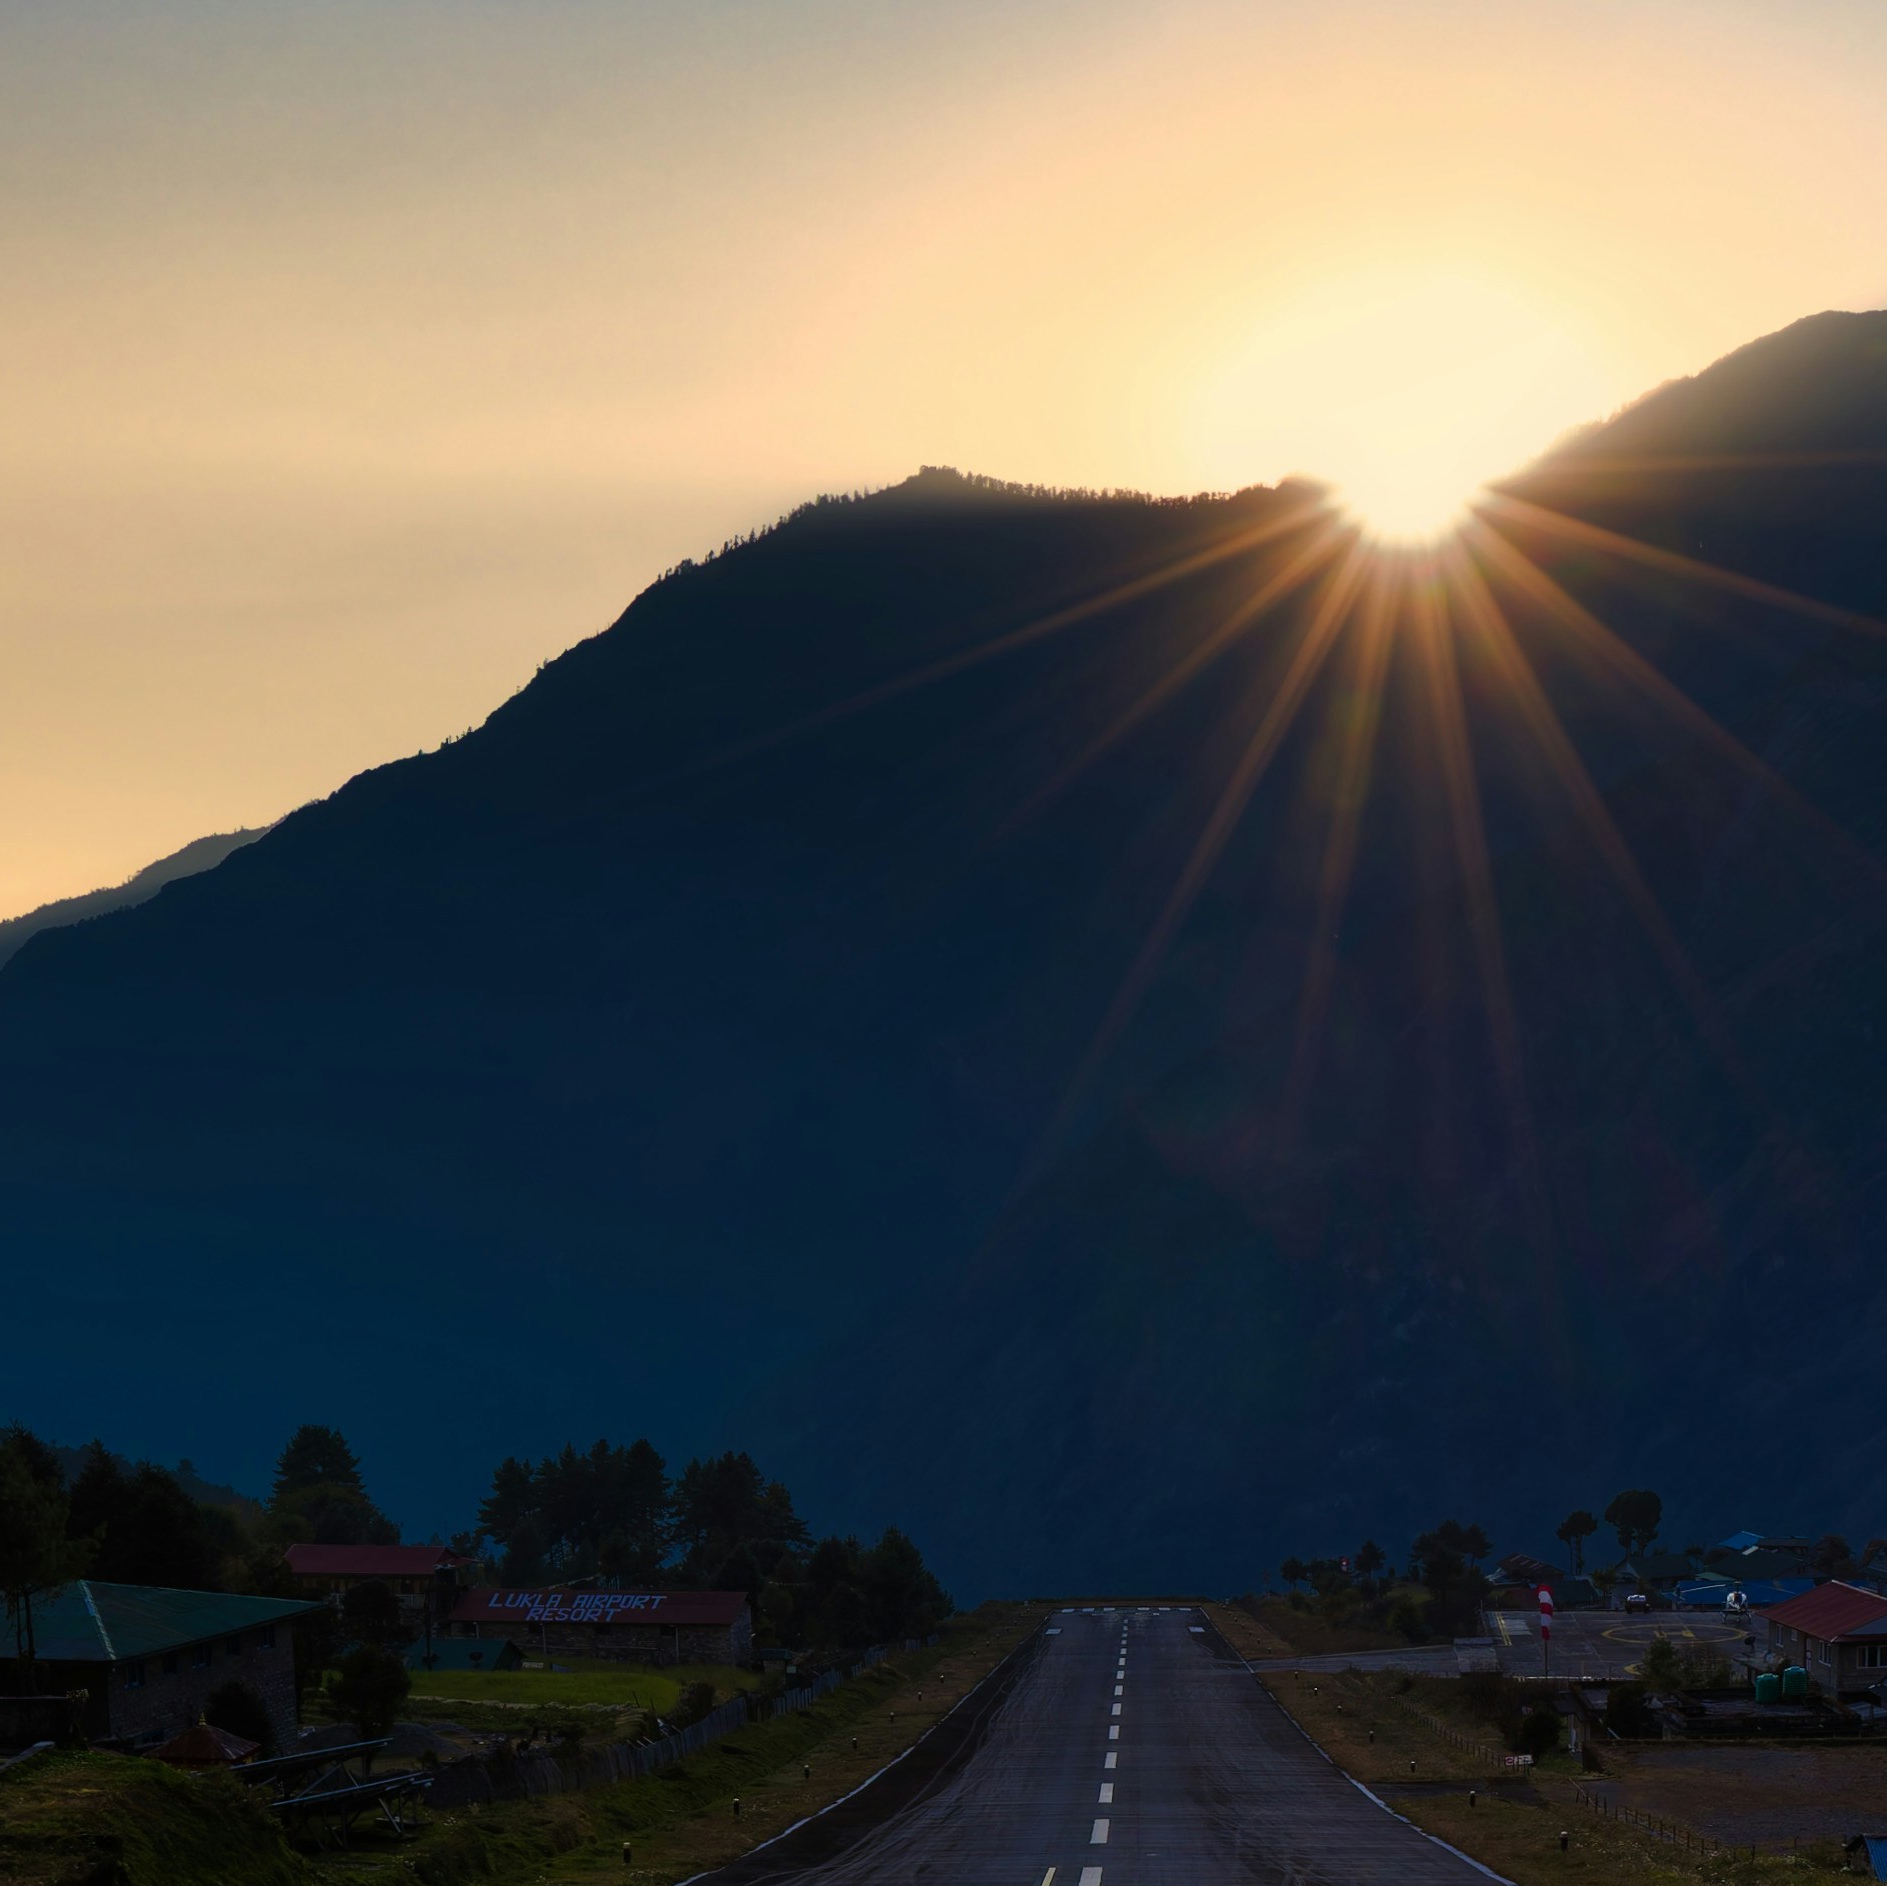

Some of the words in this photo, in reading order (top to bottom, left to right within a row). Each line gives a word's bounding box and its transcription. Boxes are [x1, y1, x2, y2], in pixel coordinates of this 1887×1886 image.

[488, 1592, 563, 1608] LUKLA
[572, 1594, 667, 1610] AIRPORT
[525, 1608, 621, 1623] RESORT
